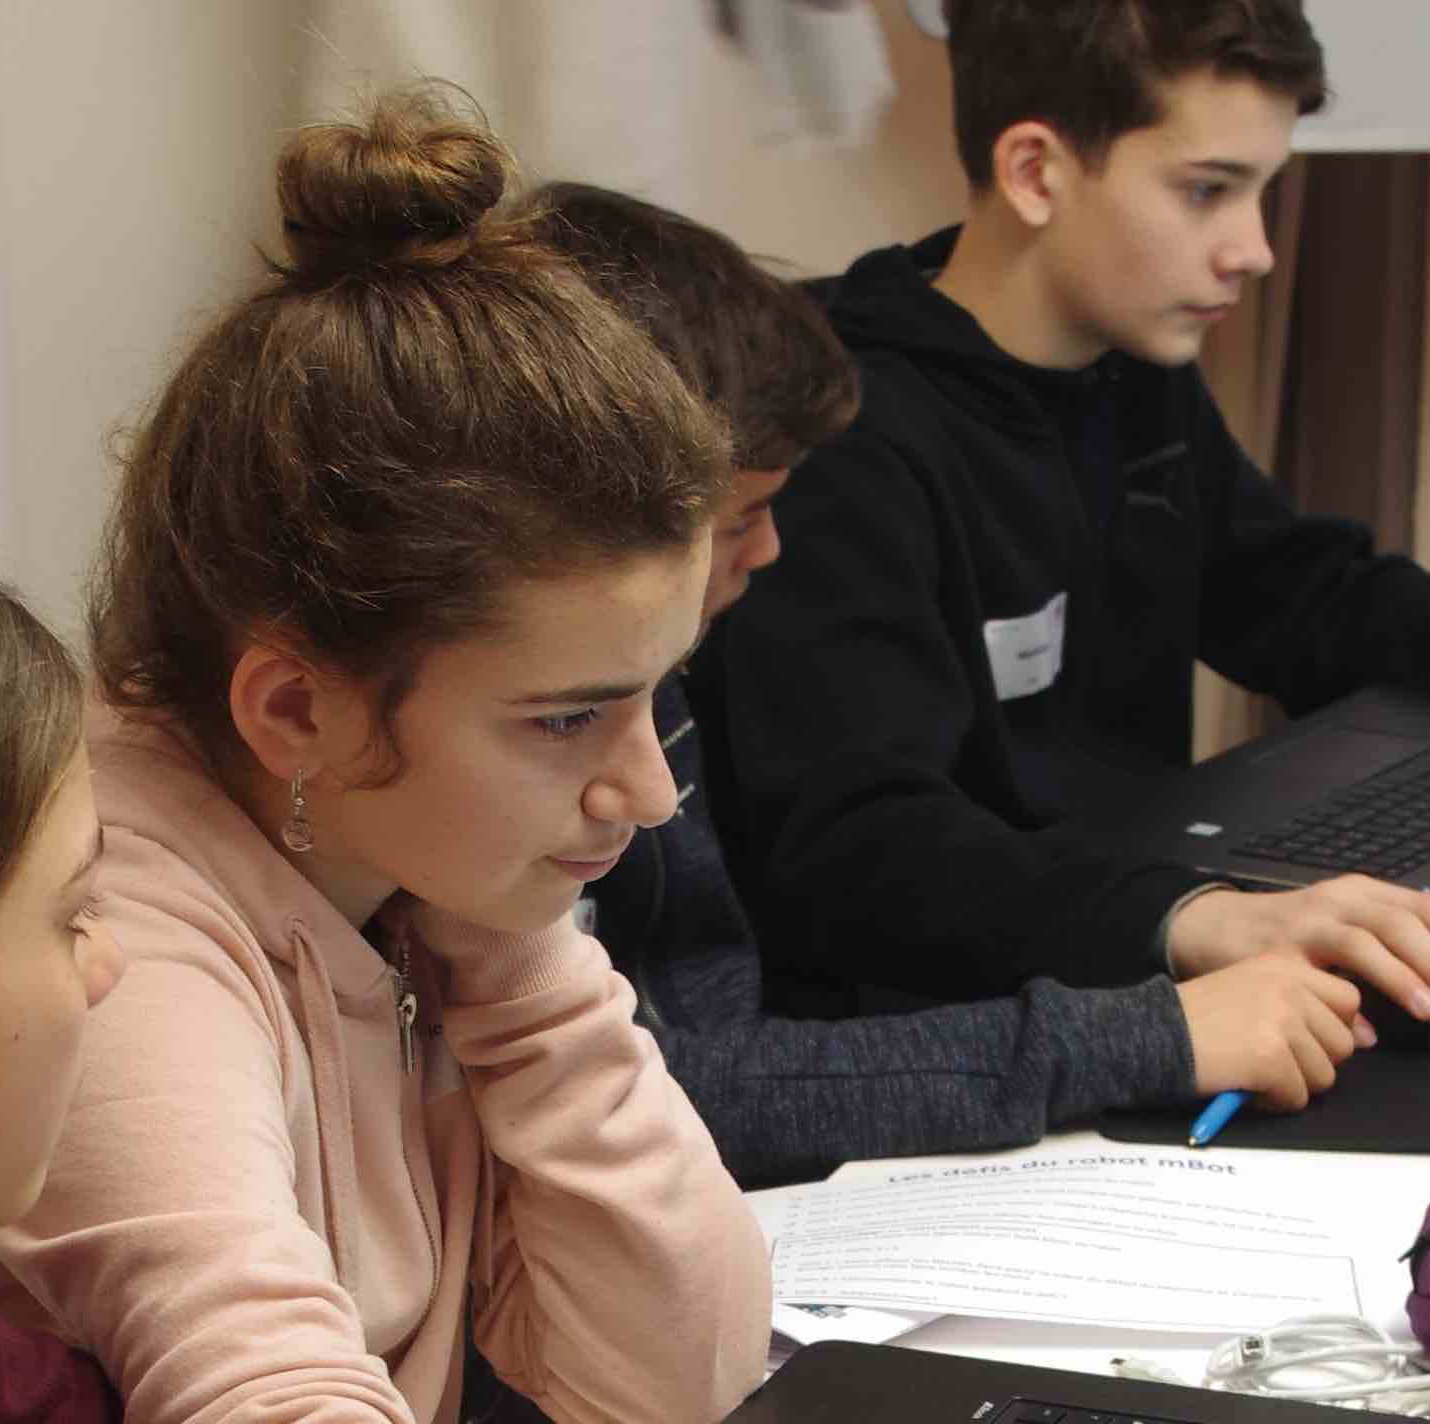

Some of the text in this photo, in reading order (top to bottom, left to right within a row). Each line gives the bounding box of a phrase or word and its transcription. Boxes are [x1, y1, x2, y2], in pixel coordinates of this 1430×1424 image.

[1023, 1158, 1056, 1171] du
[1068, 1153, 1149, 1168] robot
[1157, 1156, 1237, 1178] mBot
